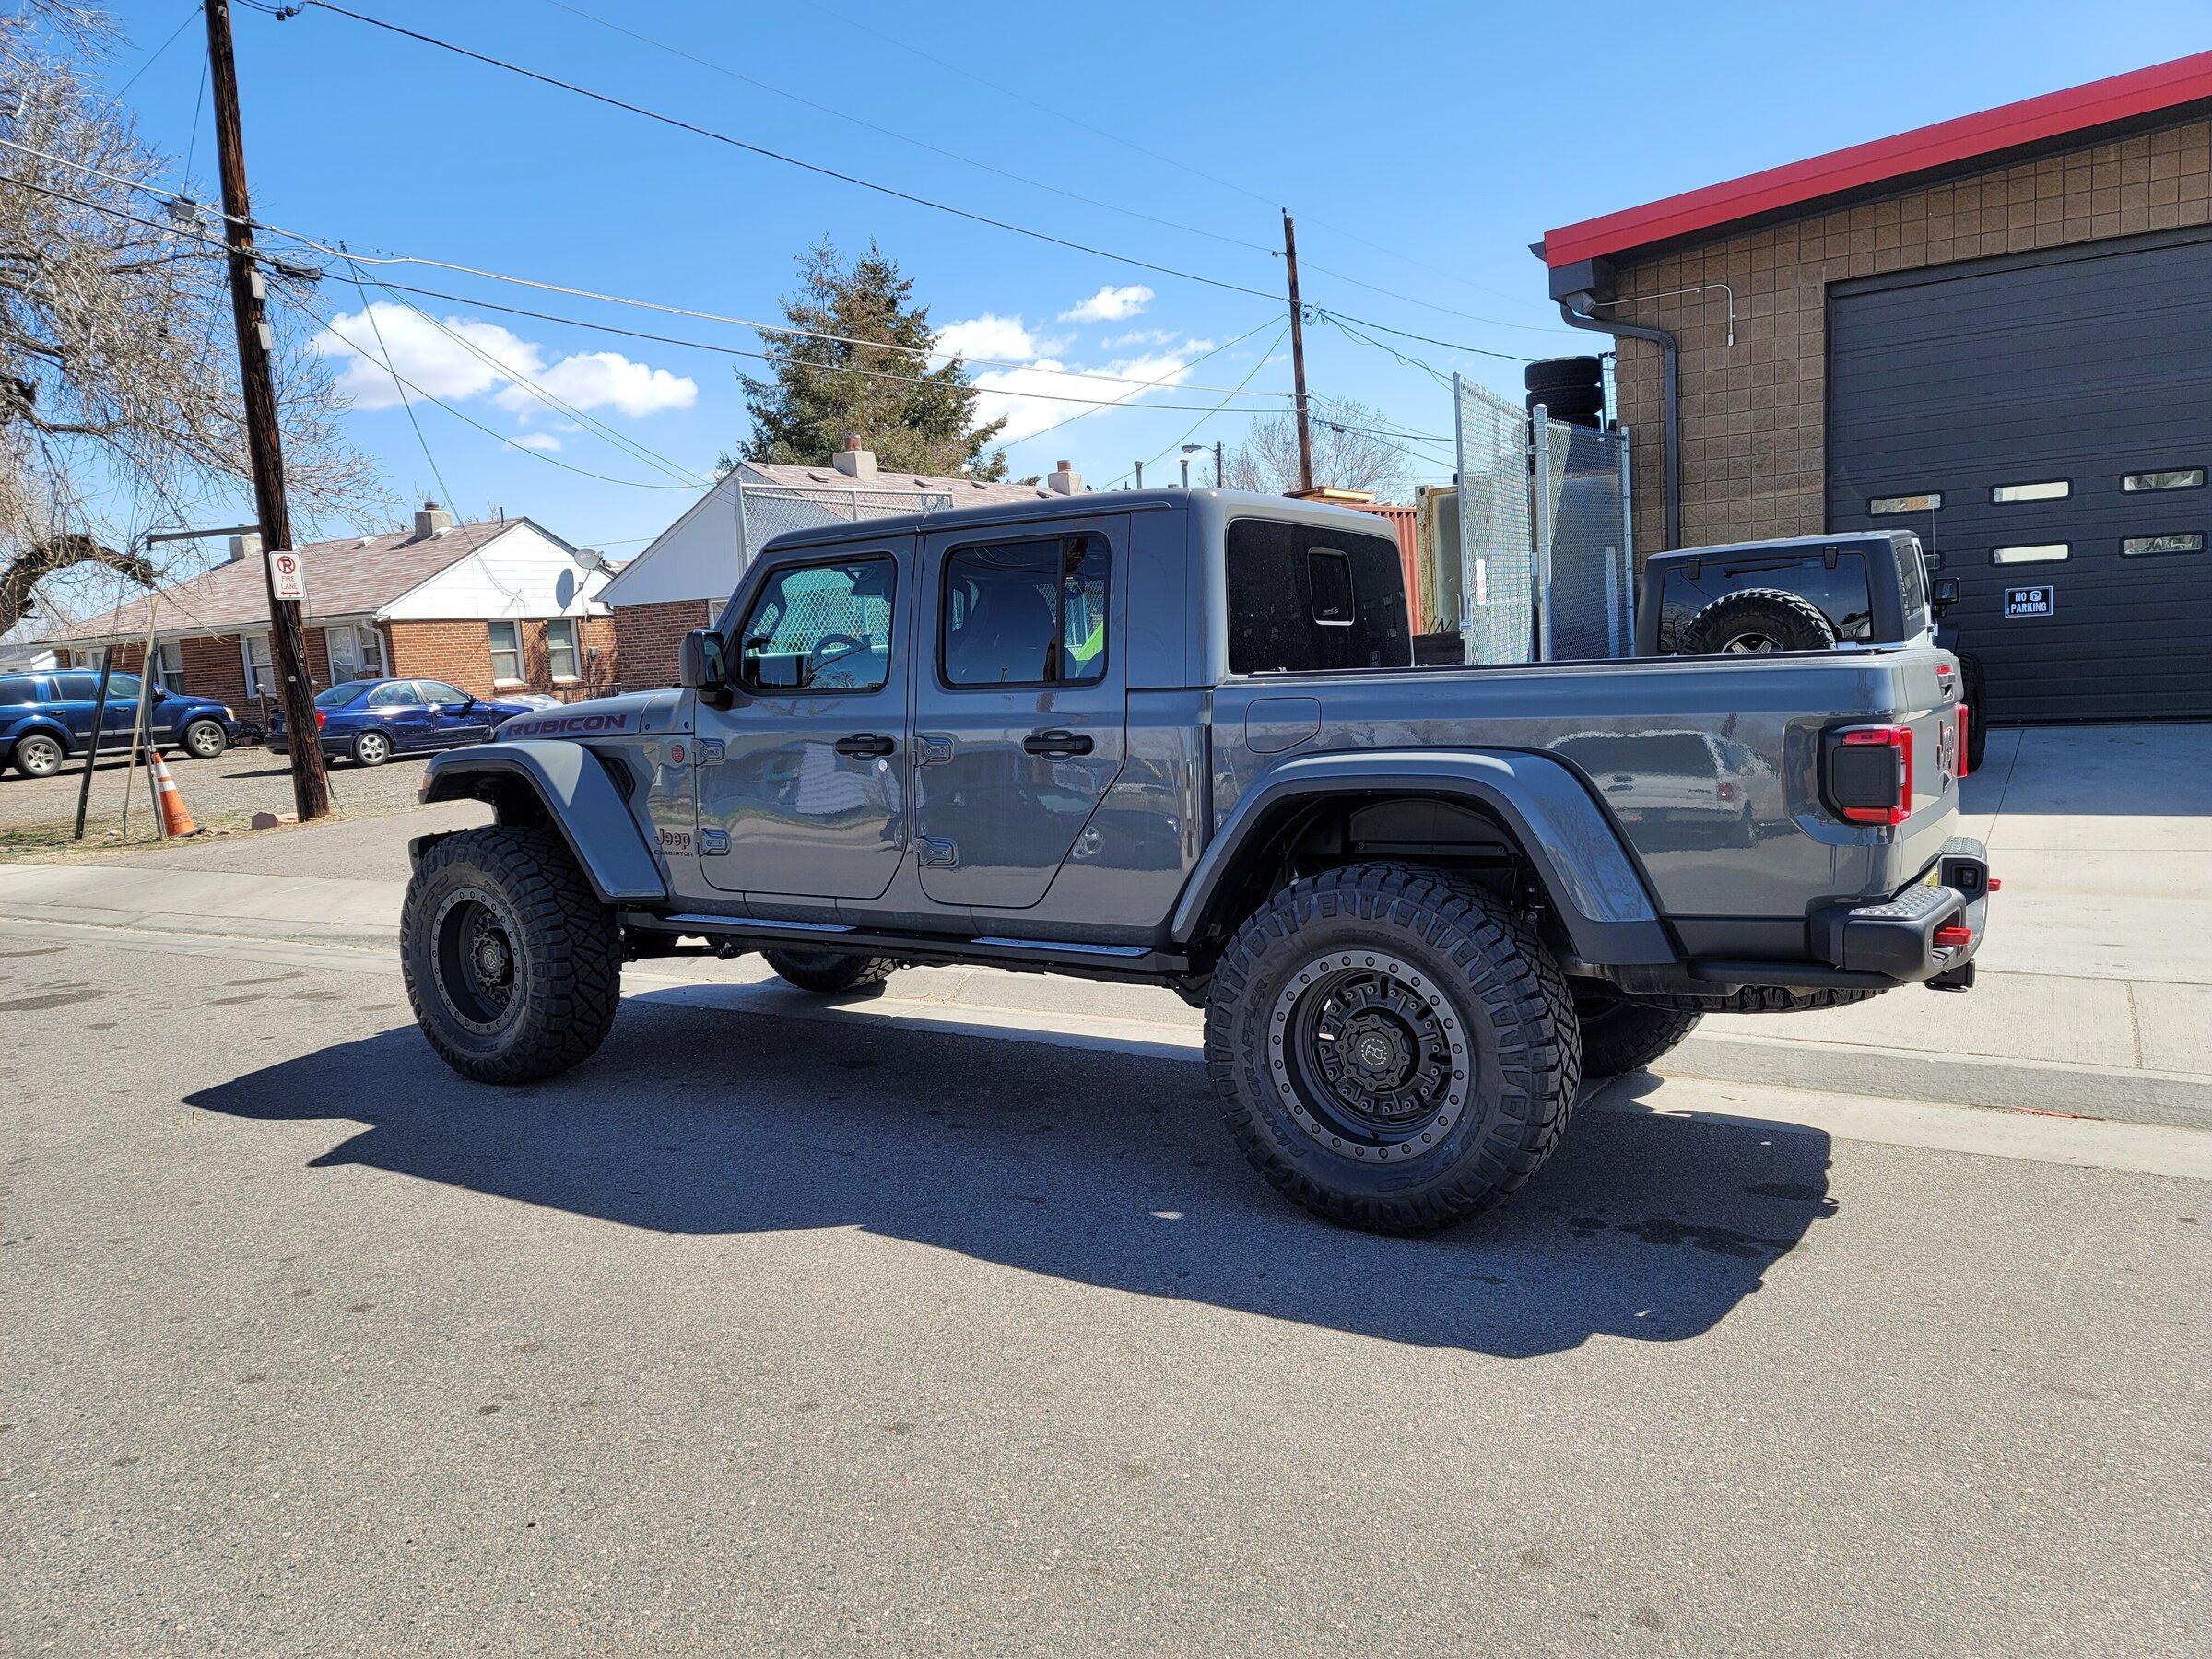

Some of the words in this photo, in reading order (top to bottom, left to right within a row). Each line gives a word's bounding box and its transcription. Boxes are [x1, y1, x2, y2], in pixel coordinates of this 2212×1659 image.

[2015, 592, 2027, 602] NO
[2010, 602, 2047, 613] PARKING
[505, 714, 628, 737] RUBICON
[653, 828, 690, 850] Jeep
